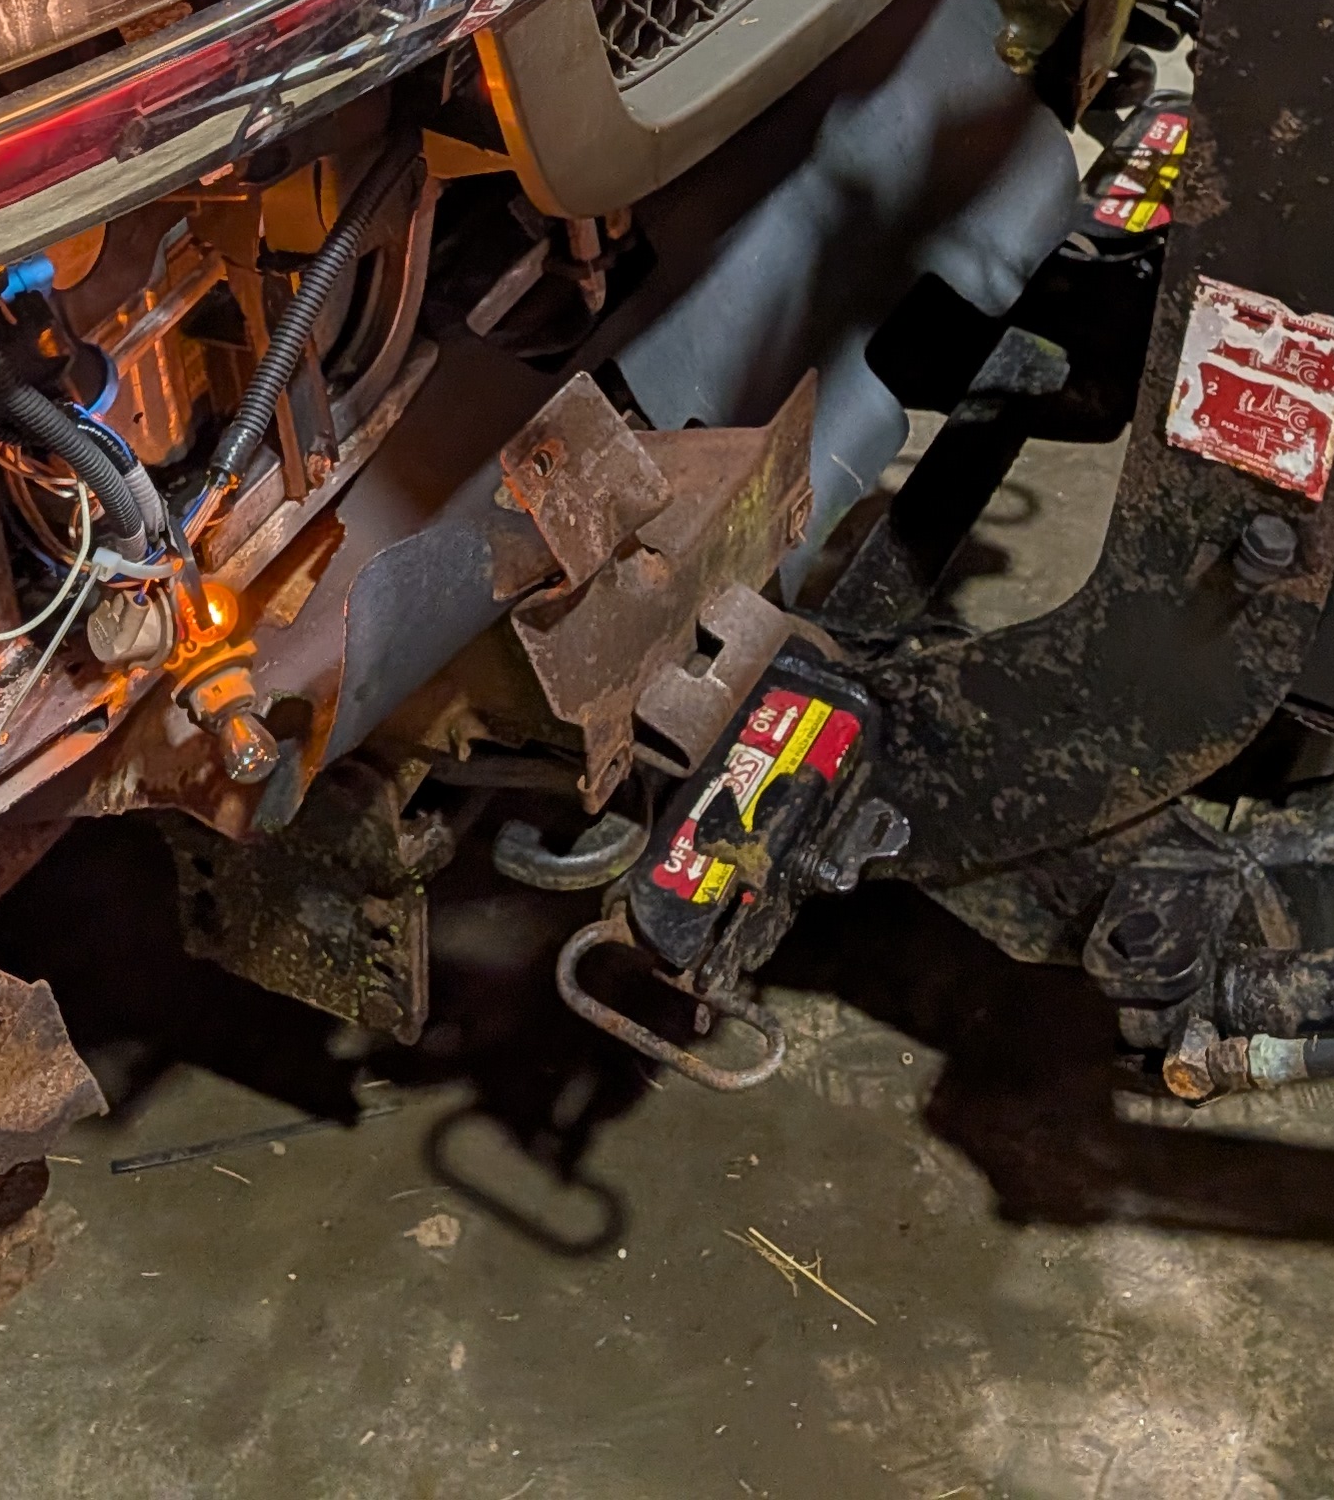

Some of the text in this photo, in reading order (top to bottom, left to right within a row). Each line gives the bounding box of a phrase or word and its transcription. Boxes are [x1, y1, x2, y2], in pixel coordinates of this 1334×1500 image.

[1206, 380, 1218, 396] 2
[1198, 413, 1210, 428] 3
[751, 706, 778, 733] ON
[722, 753, 759, 796] OSS
[663, 835, 694, 874] OFF
